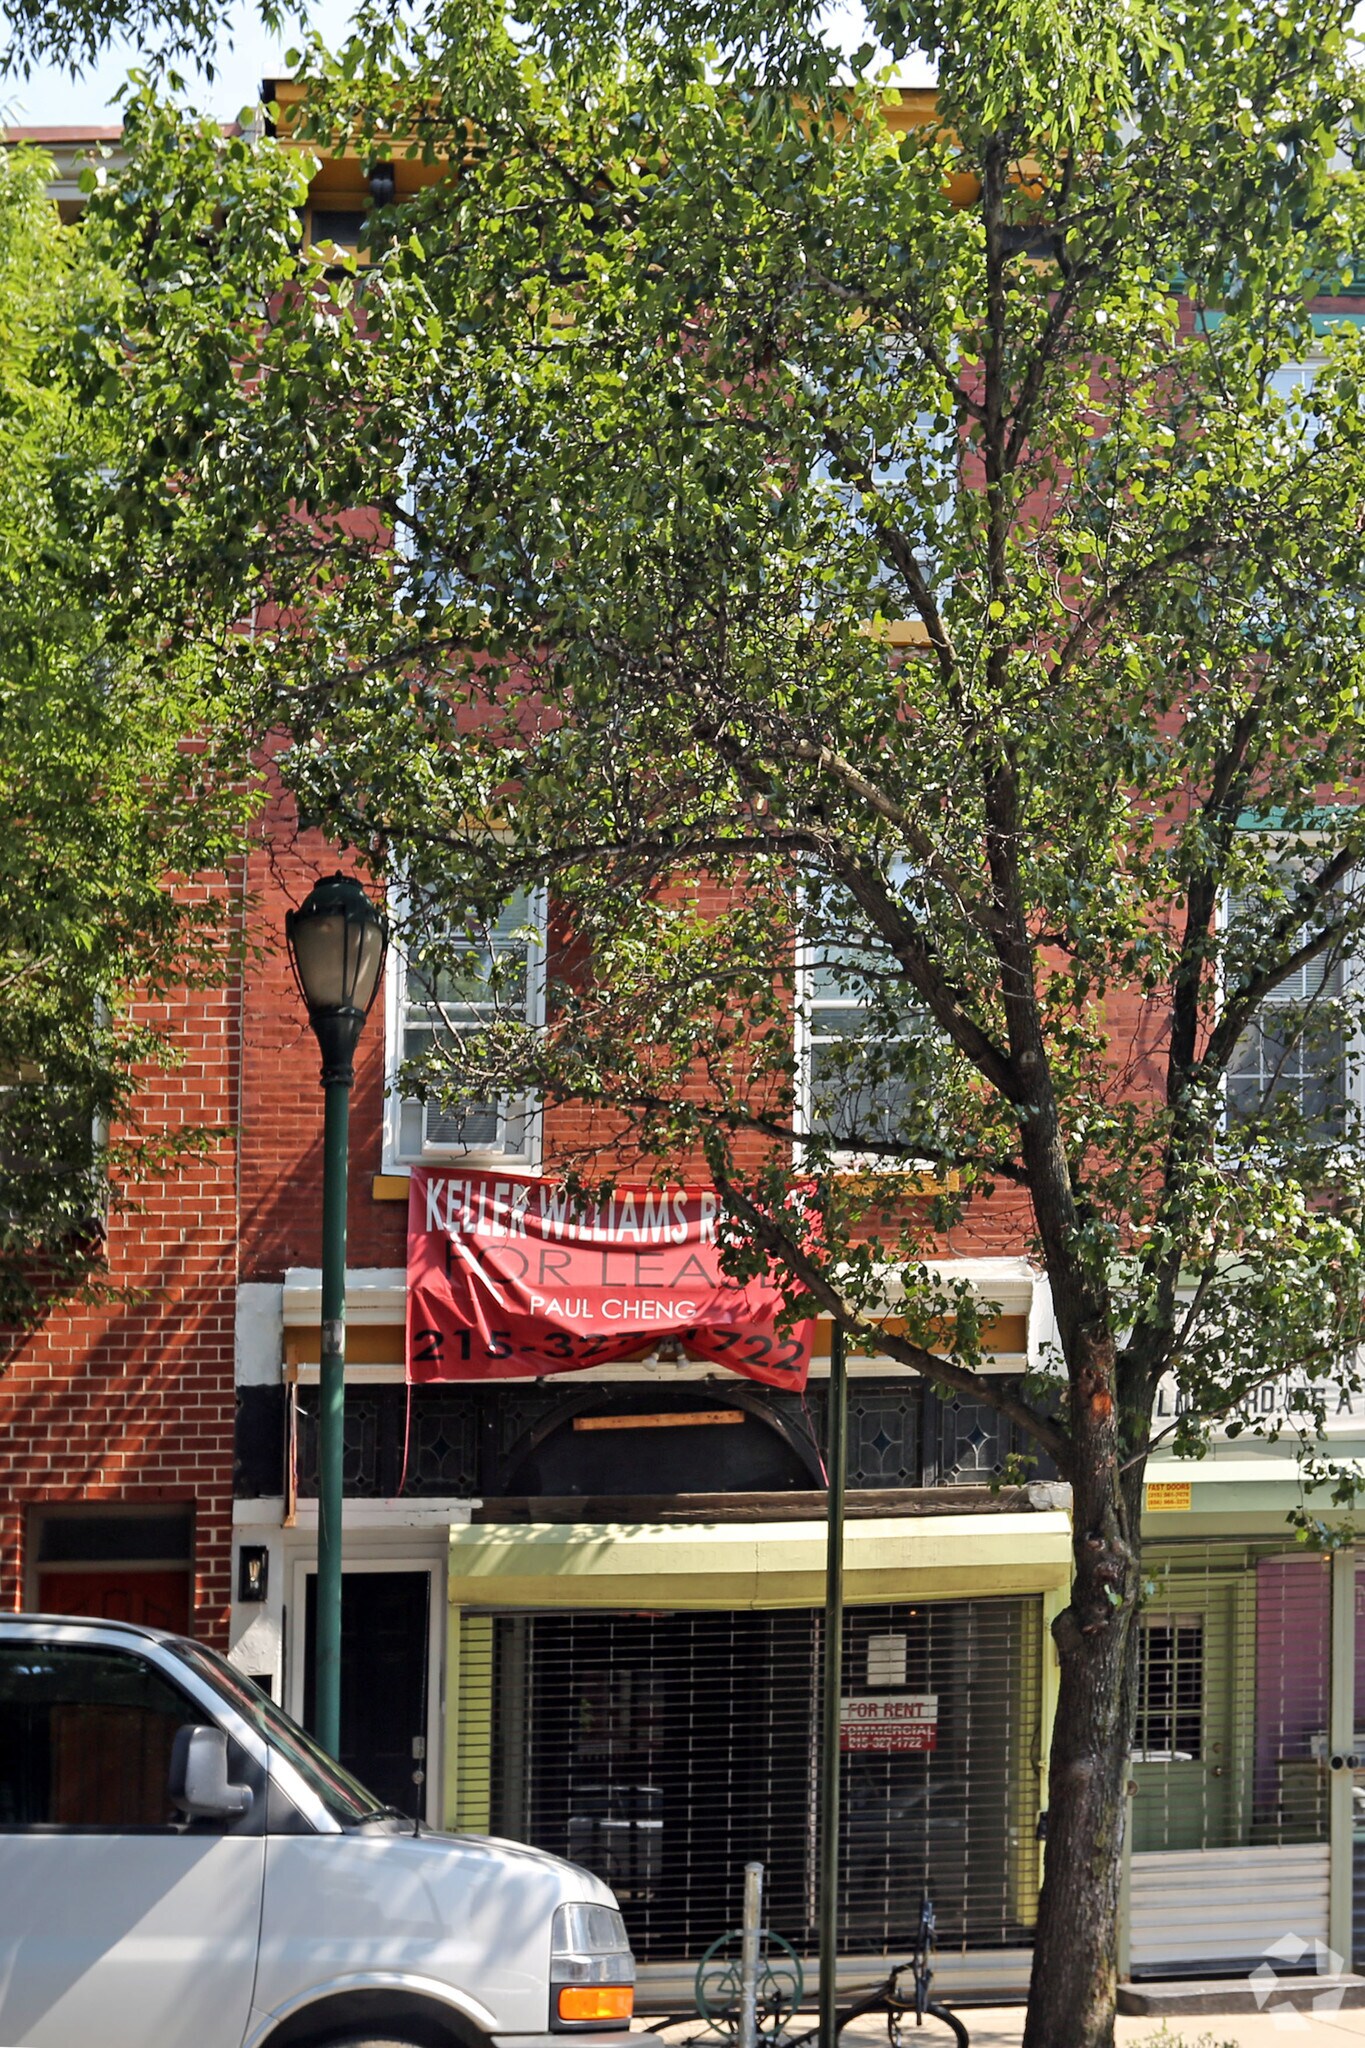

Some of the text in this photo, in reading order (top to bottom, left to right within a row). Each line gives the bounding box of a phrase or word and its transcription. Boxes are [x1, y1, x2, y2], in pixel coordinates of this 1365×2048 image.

[426, 1178, 527, 1239] KELLER
[540, 1185, 688, 1244] WILLIAMS
[446, 1240, 775, 1291] FOR LEA
[529, 1296, 697, 1320] PAUL CHENG
[1148, 1483, 1189, 1491] FAST DOORS
[848, 1702, 924, 1717] FOR RENT
[840, 1725, 936, 1736] COMMERCIAL
[848, 1736, 922, 1748] 215-327-1722
